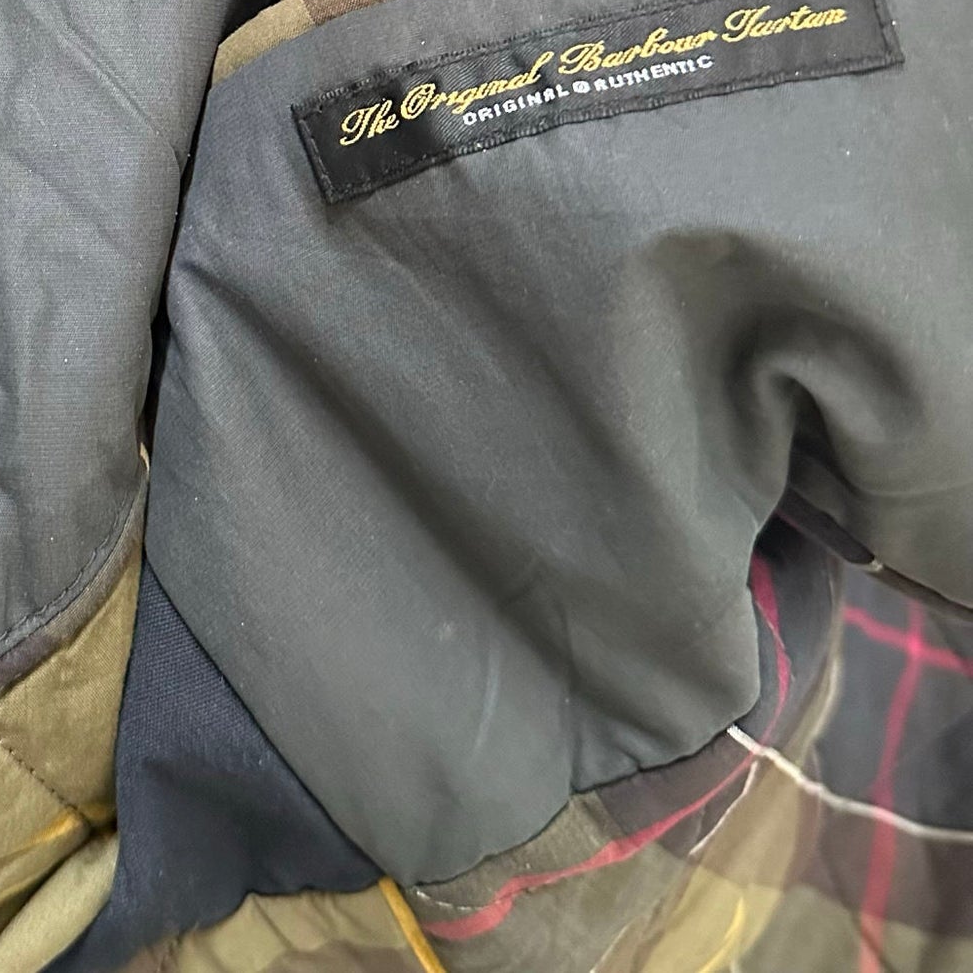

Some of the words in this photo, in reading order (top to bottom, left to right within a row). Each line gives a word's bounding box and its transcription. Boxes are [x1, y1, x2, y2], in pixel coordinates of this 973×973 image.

[339, 99, 400, 145] The
[400, 51, 555, 120] Original
[558, 28, 718, 75] Barbour
[722, 5, 848, 43] Tartan
[462, 83, 570, 126] ORIGINAL
[593, 54, 715, 92] AUTHENTIC
